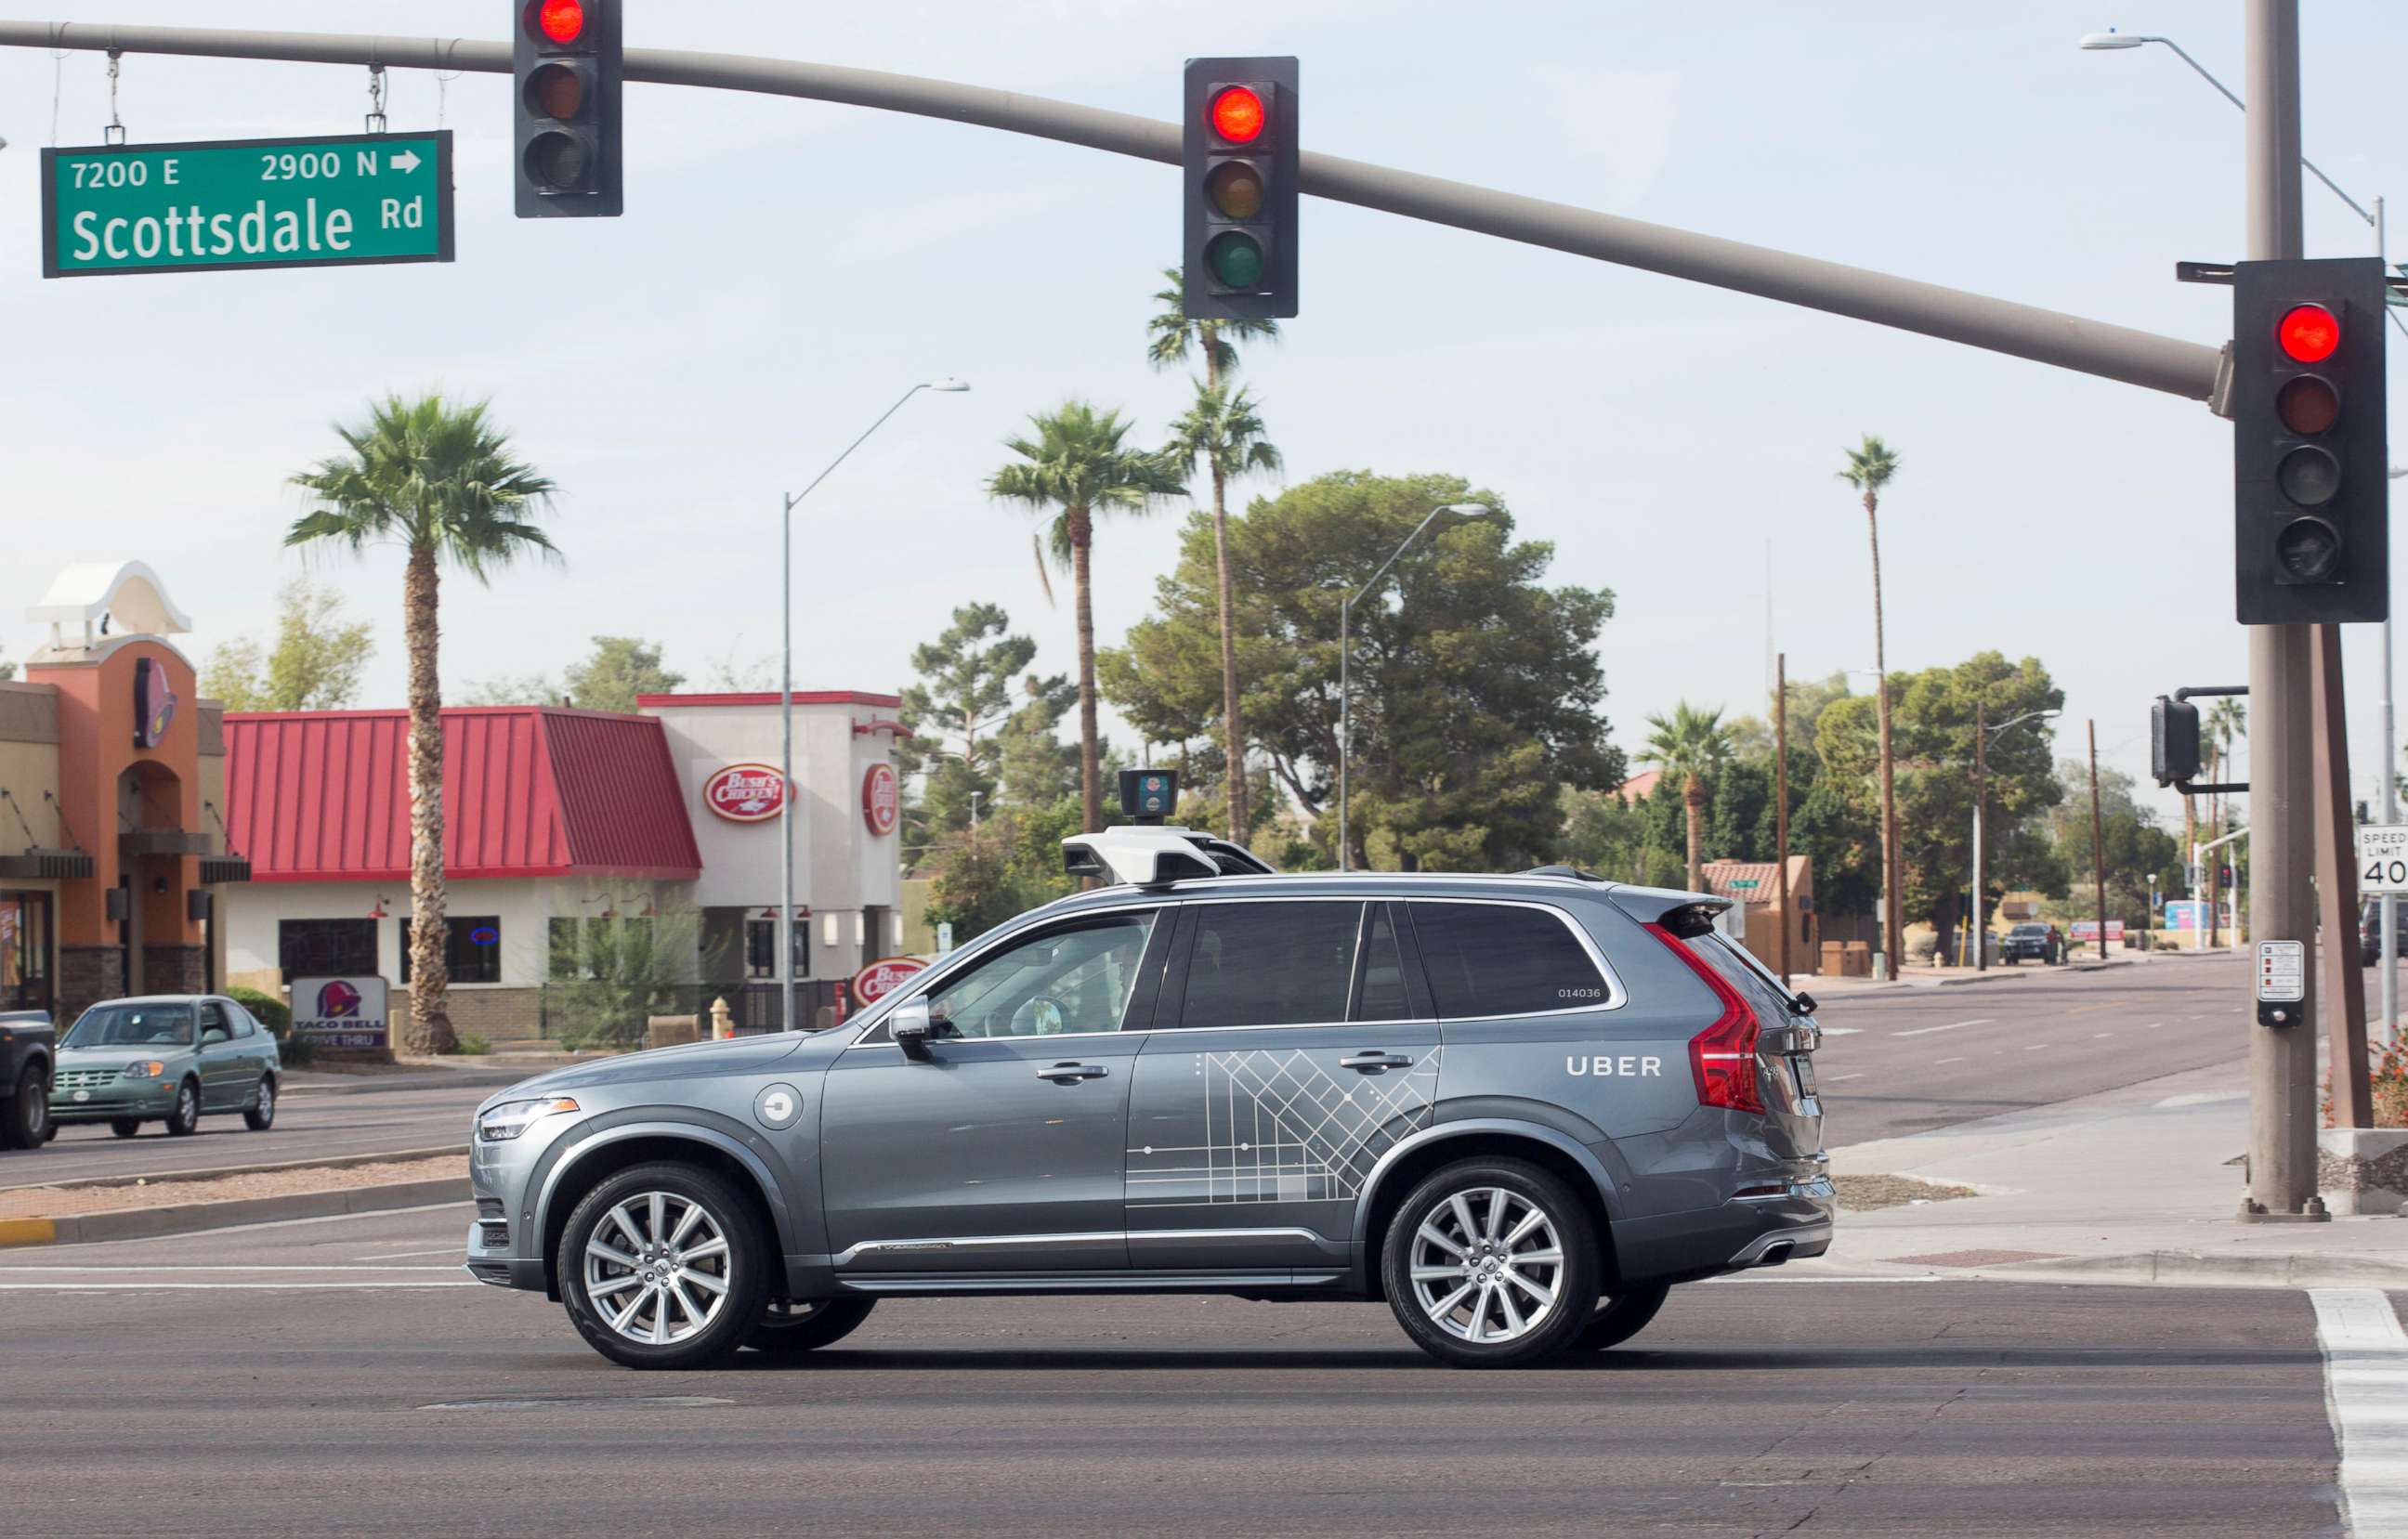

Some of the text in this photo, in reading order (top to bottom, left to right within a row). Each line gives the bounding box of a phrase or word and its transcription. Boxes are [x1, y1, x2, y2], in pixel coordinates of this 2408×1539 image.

[261, 150, 377, 181] 2900 N
[71, 159, 179, 189] 7200 E
[72, 195, 423, 261] Scottsdale Rd
[2363, 832, 2406, 844] SPEED
[2368, 846, 2401, 857] LIMIT
[2364, 860, 2406, 884] 40
[1558, 988, 1601, 998] 014036
[295, 1020, 386, 1029] TACO BELL
[342, 1034, 373, 1046] THRU
[1566, 1055, 1661, 1076] UBER
